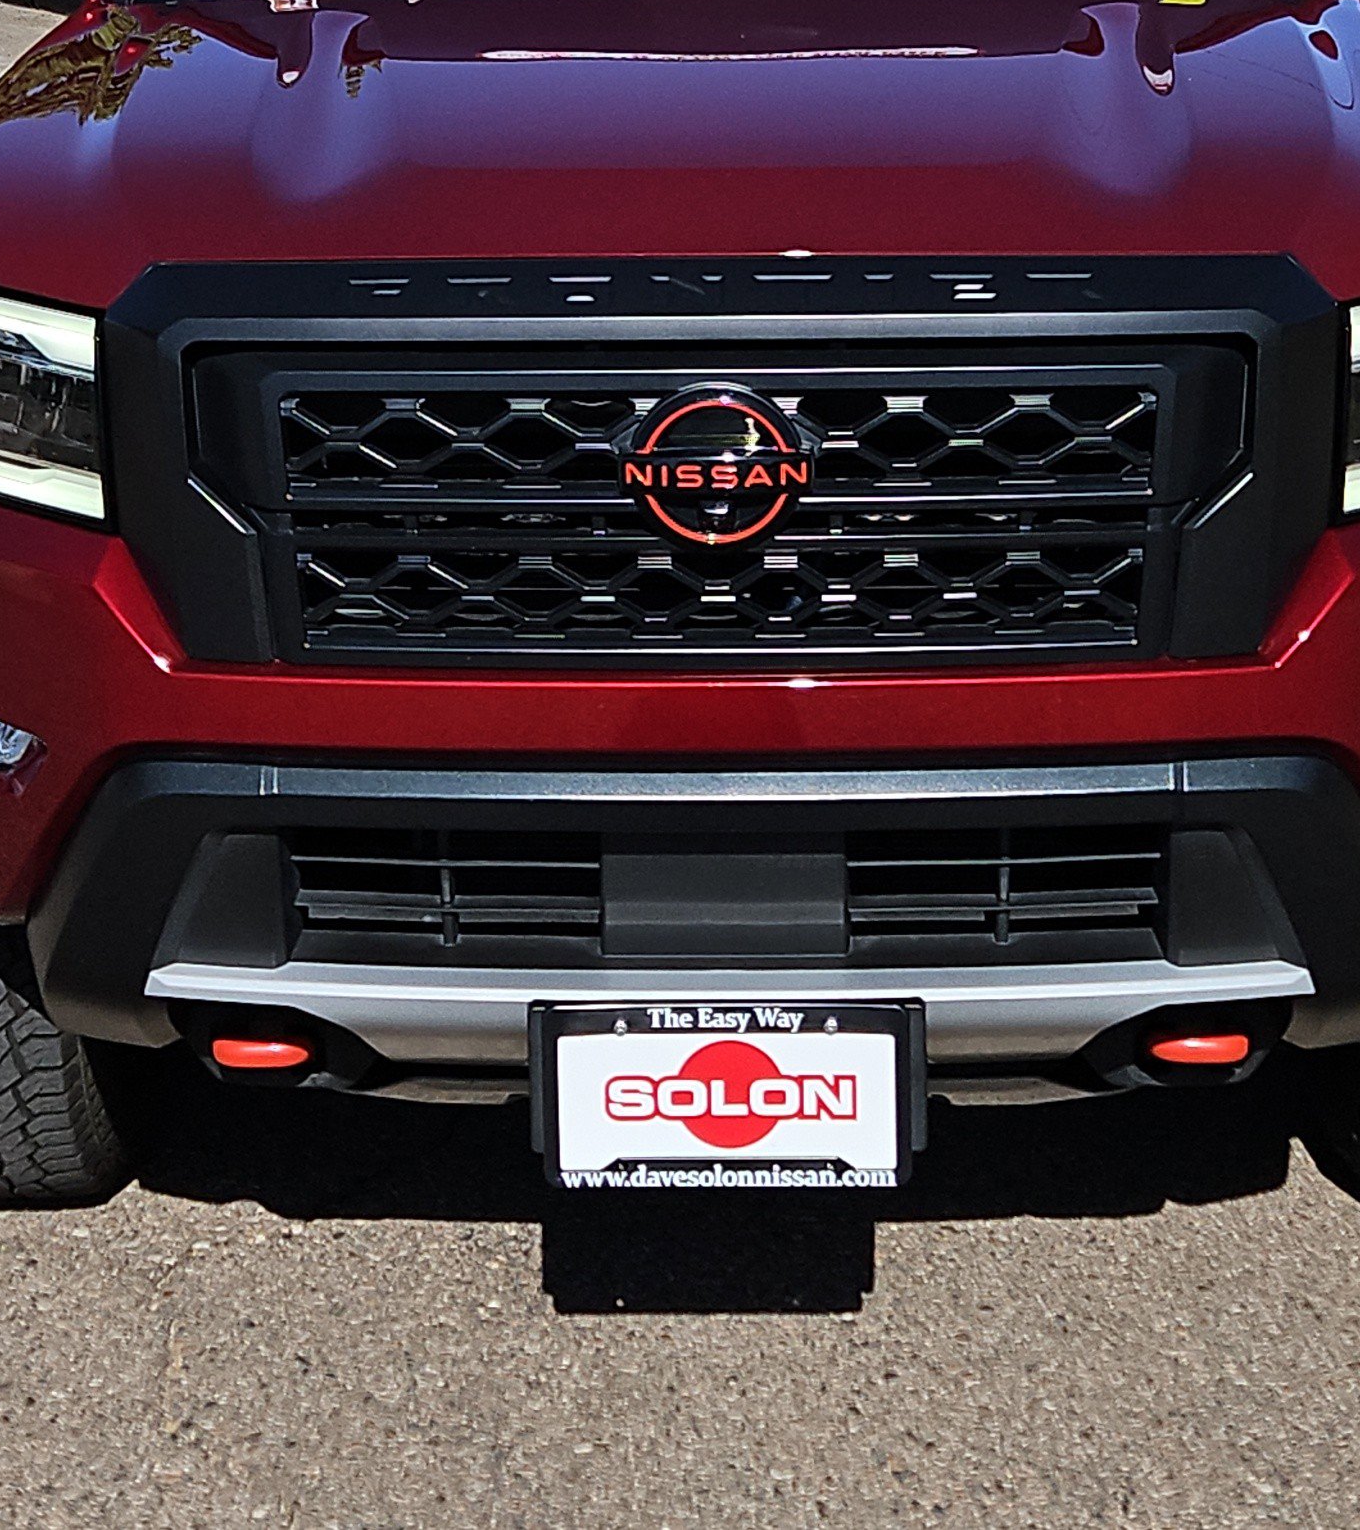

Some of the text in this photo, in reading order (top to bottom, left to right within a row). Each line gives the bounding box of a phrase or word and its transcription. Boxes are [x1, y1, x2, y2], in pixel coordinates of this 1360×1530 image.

[624, 461, 808, 489] NISSAN
[646, 1006, 805, 1034] The Easy Way
[605, 1074, 858, 1121] SOLON
[560, 1163, 898, 1189] www.davesolonnissan.com
